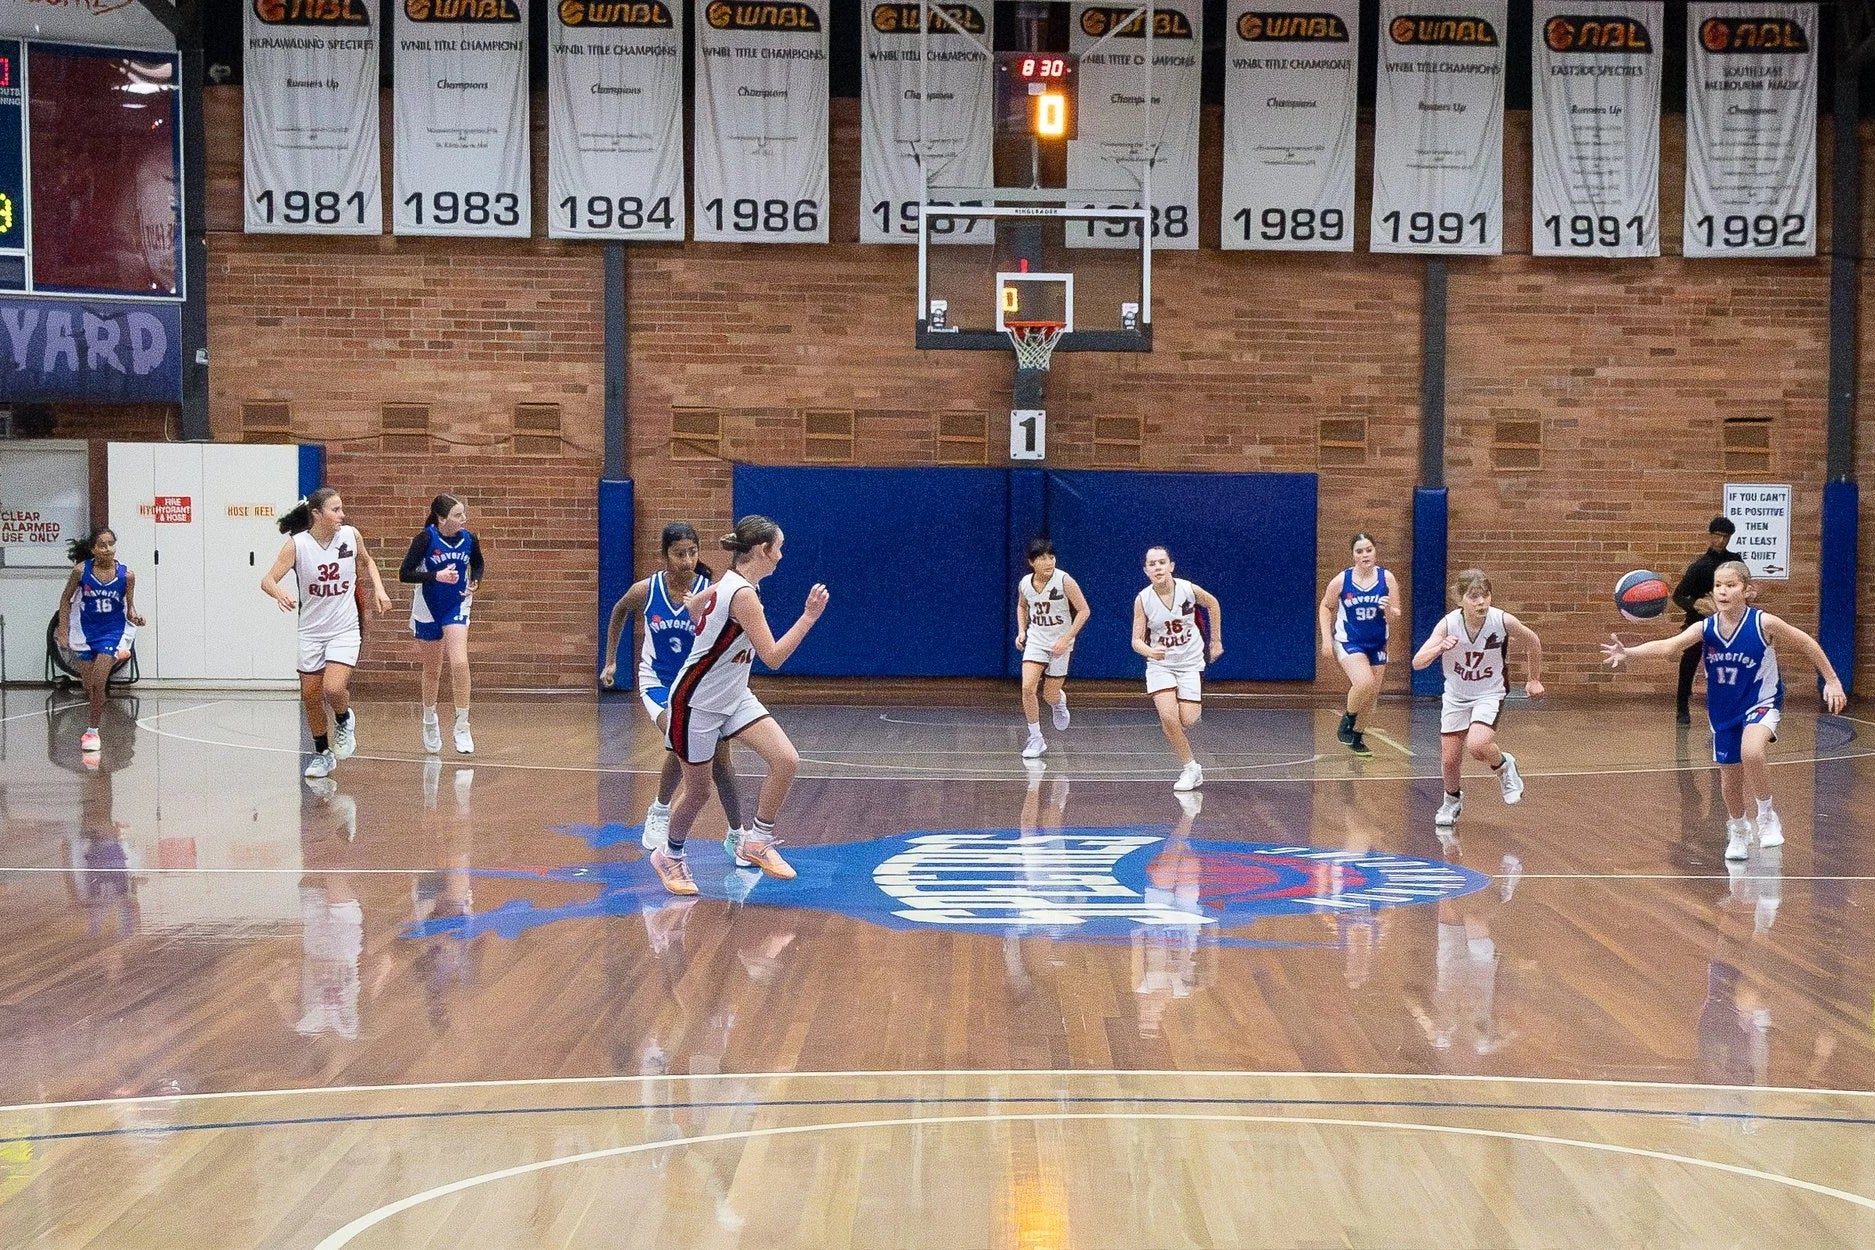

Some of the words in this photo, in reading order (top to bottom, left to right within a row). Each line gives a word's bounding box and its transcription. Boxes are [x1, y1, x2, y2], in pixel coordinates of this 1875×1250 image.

[435, 0, 515, 18] WNBL
[589, 3, 667, 24] WNBL
[735, 6, 815, 27] WNBL
[1266, 17, 1343, 37] WNBL
[1418, 20, 1492, 42] WNBL
[1578, 21, 1646, 47] NBL
[1733, 23, 1801, 48] NBL
[400, 40, 431, 51] WNBL
[434, 40, 456, 51] TITLE
[555, 44, 583, 56] WNBL
[587, 44, 610, 56] TITLE
[613, 45, 677, 57] CHAMPIONS
[703, 47, 731, 58] WNBL
[735, 47, 758, 59] TITLE
[761, 47, 825, 60] CHAMPIONS
[901, 50, 920, 61] TITL
[1232, 59, 1262, 69] WNBL
[1385, 62, 1414, 73] WNBL
[436, 79, 489, 92] Champions
[590, 83, 642, 97] Champions
[1039, 95, 1064, 134] 0
[256, 190, 366, 225] 1981
[404, 191, 520, 226] 1983
[559, 195, 675, 230] 1984
[705, 197, 819, 232] 1986
[1233, 207, 1344, 241] 1989
[1382, 210, 1488, 244] 1991
[1545, 213, 1645, 247] 1991
[1697, 213, 1807, 248] 1992
[1019, 416, 1036, 452] 1
[164, 498, 182, 506] FIRE
[1729, 492, 1737, 501] IF
[1740, 492, 1758, 502] YOU
[1760, 492, 1787, 502] CAN'T
[1, 511, 41, 521] CLEAR
[155, 505, 191, 514] HYDRANT
[167, 513, 187, 522] HOSE
[227, 506, 249, 517] HOSE
[254, 506, 275, 517] REEL
[1730, 507, 1743, 516] BE
[1745, 507, 1785, 517] POSITIVE
[2, 522, 61, 532] ALARMED
[1746, 522, 1769, 531] THEN
[2, 533, 24, 543] USE
[29, 533, 60, 543] ONLY
[1736, 536, 1748, 546] AT
[1749, 536, 1778, 546] LEAST
[1750, 550, 1777, 560] QUIET
[317, 562, 341, 582] 32
[308, 580, 350, 598] BULLS
[95, 598, 113, 613] 16
[1355, 607, 1378, 621] 90
[1164, 618, 1184, 635] 16
[668, 636, 683, 654] 3
[1464, 651, 1485, 670] 17
[1454, 661, 1494, 681] BULLS
[1716, 666, 1739, 686] 17
[873, 834, 1217, 925] SPECTRES
